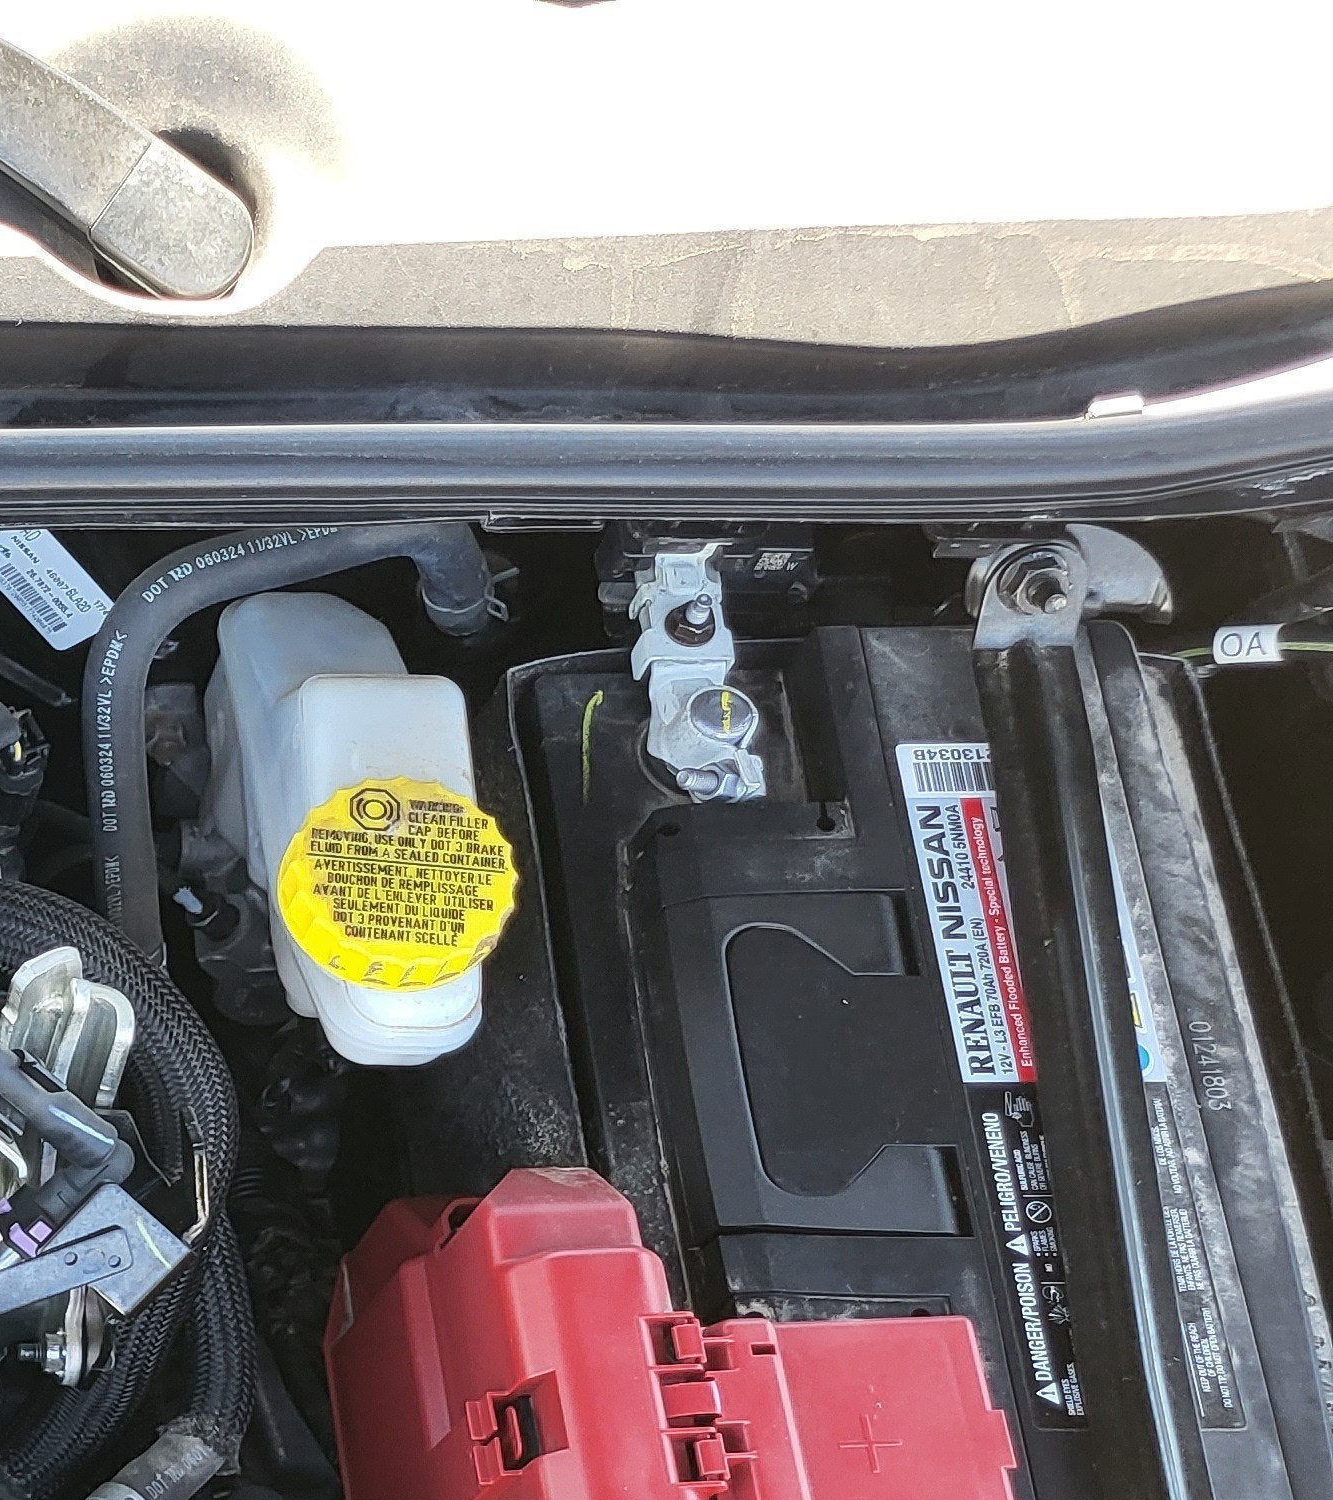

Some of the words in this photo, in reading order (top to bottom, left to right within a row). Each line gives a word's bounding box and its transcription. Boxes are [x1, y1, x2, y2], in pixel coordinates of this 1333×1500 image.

[10, 533, 39, 565] NISSAN
[137, 575, 173, 605] DOT
[194, 542, 246, 570] 060324
[99, 742, 115, 786] 060324
[102, 812, 118, 831] DOT
[407, 811, 446, 826] CLEAN
[448, 815, 488, 829] FILLER
[408, 824, 431, 837] CAP
[437, 826, 479, 841] BEFORE
[310, 840, 341, 854] FLUID
[346, 843, 379, 857] FROM
[381, 847, 390, 858] A
[394, 848, 439, 863] SEALED
[375, 833, 394, 846] USE
[397, 835, 426, 849] ONLY
[430, 839, 450, 851] DOT
[455, 841, 462, 852] 3
[465, 842, 504, 856] BRAKE
[968, 815, 993, 875] technology
[416, 867, 474, 883] NETTOYER
[477, 873, 492, 885] LE
[916, 805, 968, 940] NISSAN
[955, 850, 975, 890] 24410
[313, 883, 353, 897] AVANT
[357, 888, 370, 898] DE
[443, 896, 493, 911] UTILISER
[327, 873, 377, 887] BOUCHON
[381, 878, 395, 888] DE
[398, 879, 478, 896] REMPLISSAGE
[981, 876, 1001, 916] Special
[332, 911, 353, 922] DOT
[357, 913, 364, 923] 3
[367, 914, 436, 930] PROVENANT
[439, 920, 464, 933] D'UN
[333, 898, 398, 914] SEULEMENT
[404, 905, 418, 916] DU
[422, 906, 465, 920] LIQUIDE
[344, 925, 411, 941] CONTENANT
[968, 915, 987, 942] (EN)
[975, 942, 991, 970] 720A
[991, 923, 1012, 965] Battery
[981, 972, 998, 1001] 70Ah
[1000, 965, 1019, 1011] Flooded
[949, 949, 996, 1078] RENAULT
[987, 1002, 1003, 1028] EFB
[993, 1028, 1007, 1044] L3
[1010, 1011, 1032, 1068] Enhanced
[998, 1051, 1013, 1074] 12V
[1187, 1017, 1231, 1113] 01241803
[981, 1110, 1021, 1233] PELIGRO/VENENO
[1012, 1260, 1052, 1382] DANGER/POISON
[1070, 1382, 1084, 1416] EXPLOSIVE
